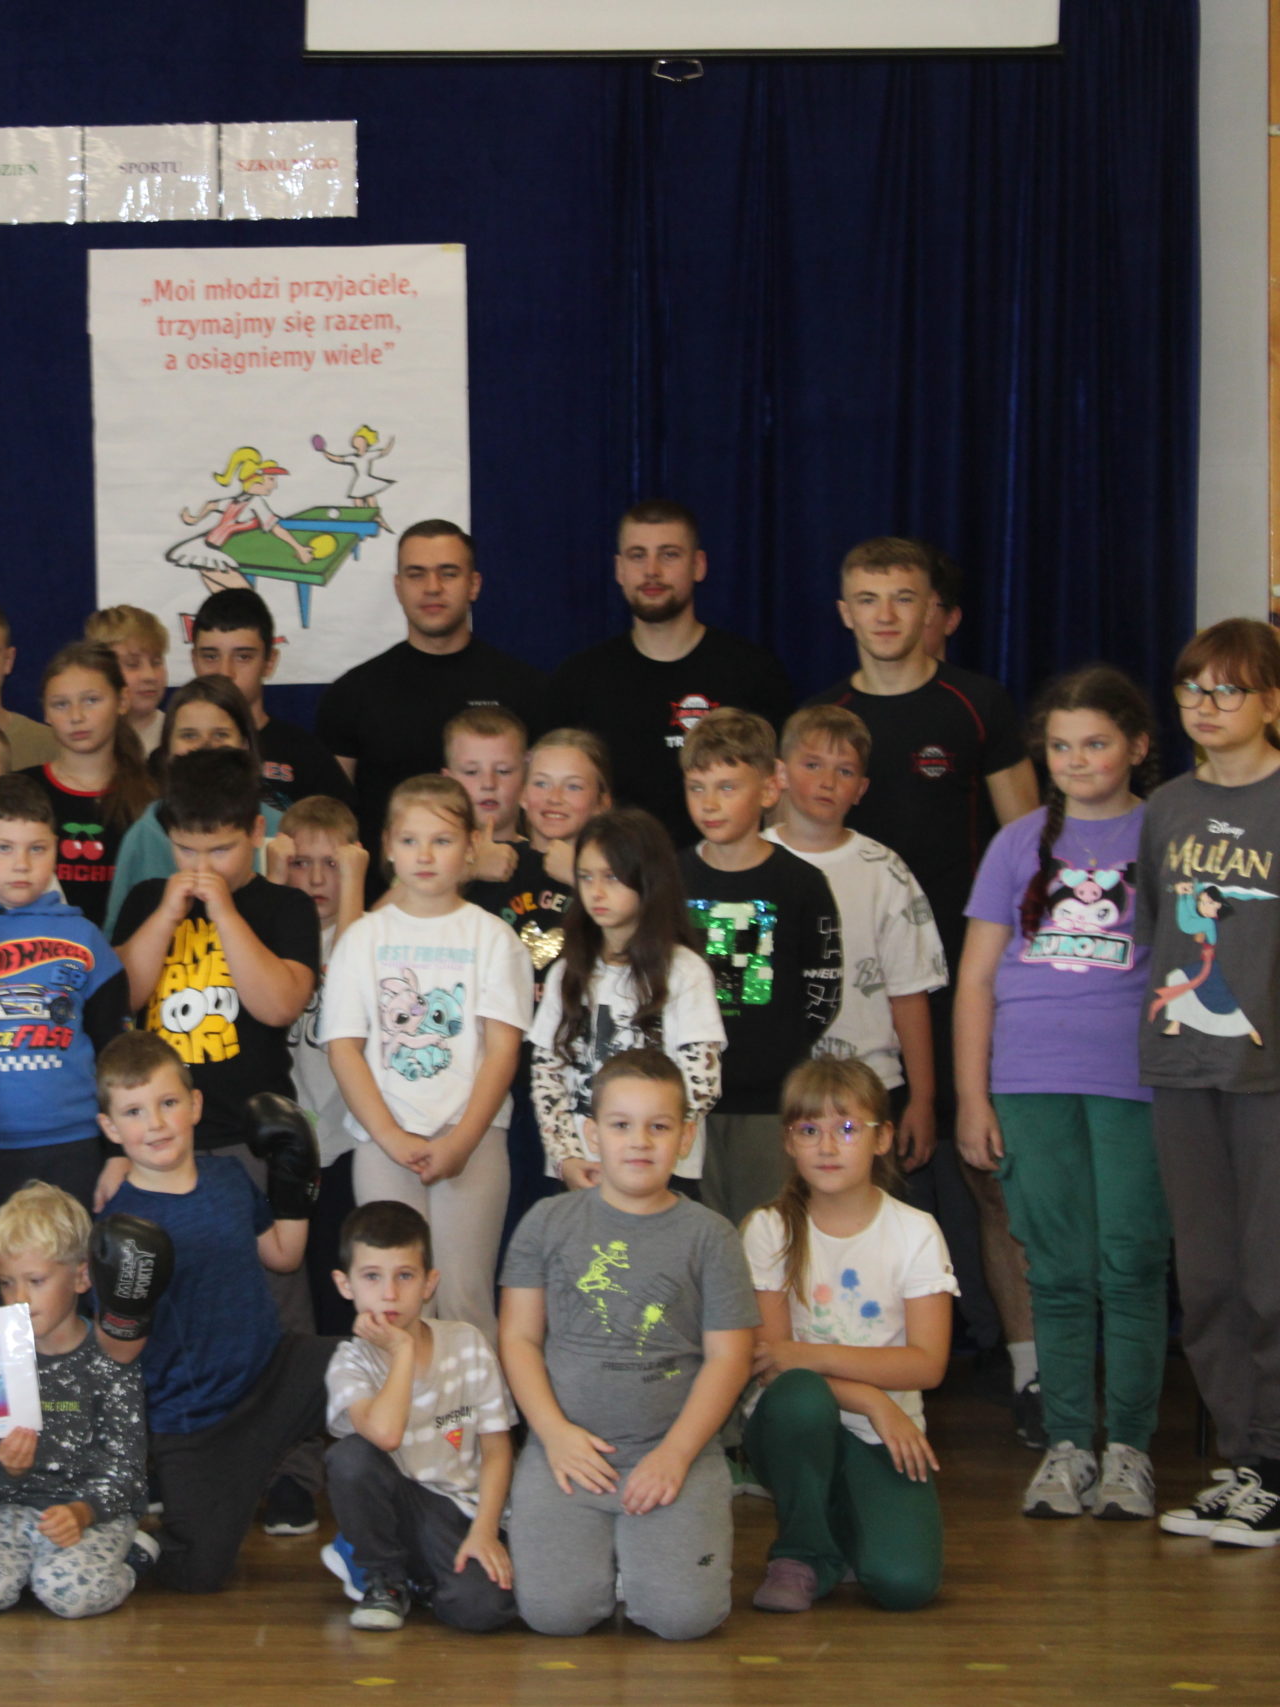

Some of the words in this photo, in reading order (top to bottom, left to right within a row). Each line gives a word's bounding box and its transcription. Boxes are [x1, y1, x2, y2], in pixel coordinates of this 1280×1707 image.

[119, 160, 184, 175] SPORTU
[204, 276, 280, 301] młodzi
[288, 273, 418, 303] przyjaciele,
[157, 314, 276, 340] trzymajmy
[283, 312, 316, 338] się
[323, 312, 402, 334] razem,
[164, 354, 178, 370] a
[186, 346, 316, 376] osiągniemy
[1207, 818, 1246, 840] Disney
[1166, 835, 1273, 881] MULAN
